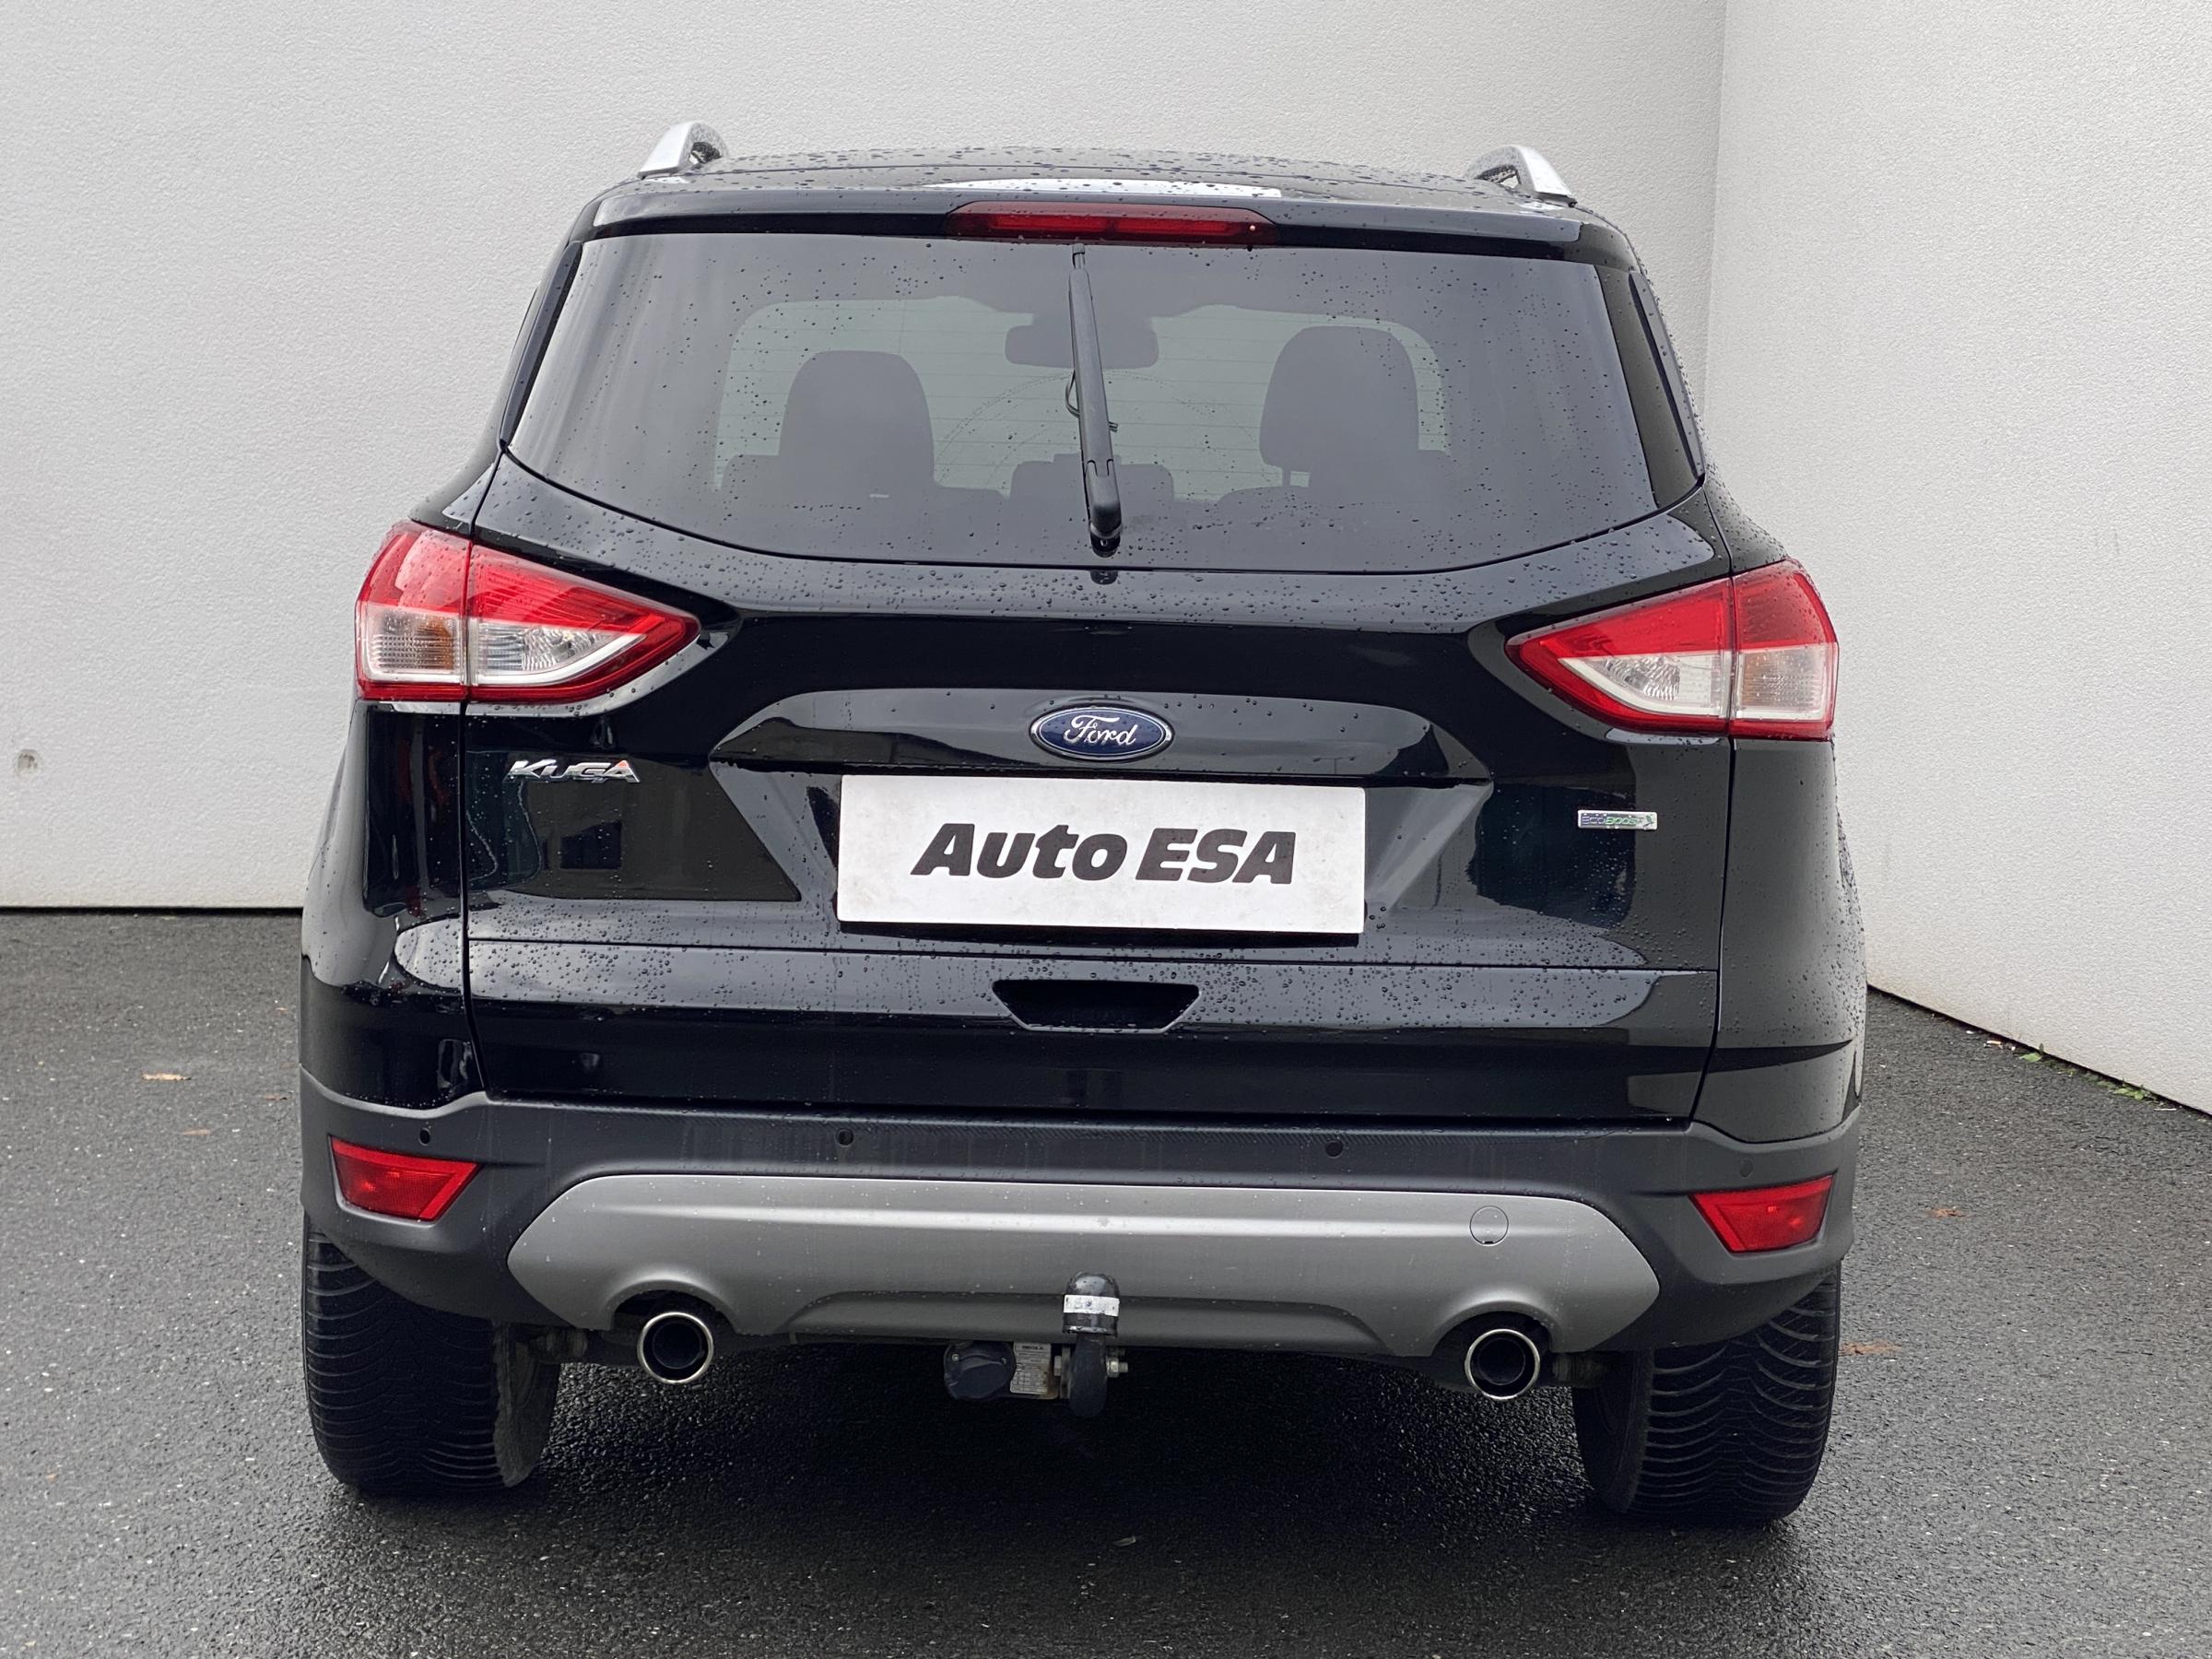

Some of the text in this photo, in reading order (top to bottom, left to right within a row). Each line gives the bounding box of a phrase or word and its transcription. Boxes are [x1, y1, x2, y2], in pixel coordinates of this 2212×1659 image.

[1063, 714, 1138, 746] Ford
[508, 759, 641, 783] KUGA
[910, 823, 1297, 885] Auto ESA
